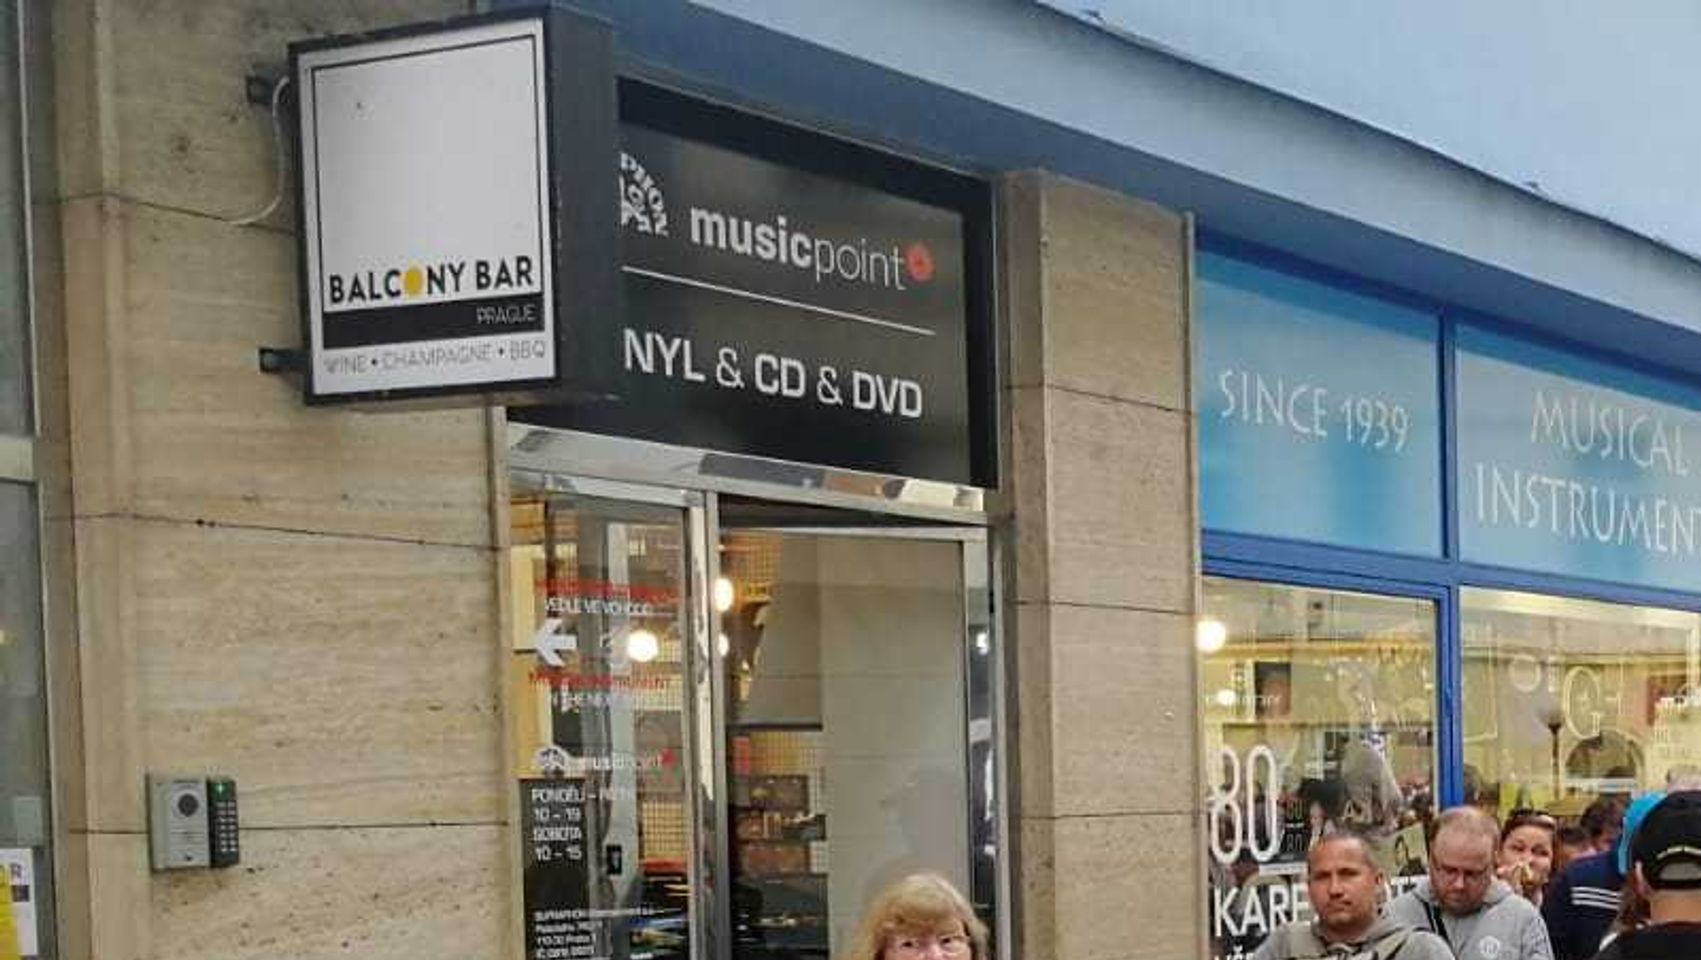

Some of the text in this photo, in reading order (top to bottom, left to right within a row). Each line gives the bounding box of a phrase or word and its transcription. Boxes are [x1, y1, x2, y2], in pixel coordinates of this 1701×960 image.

[329, 255, 533, 304] BALCONY BAR
[690, 206, 906, 290] musicpoint
[476, 303, 537, 325] PRAGUE
[381, 344, 493, 370] CHAMPAGNE
[510, 339, 546, 361] BBQ
[623, 328, 922, 418] NYL & CD & DVD
[1218, 368, 1410, 452] SINCE 1939
[1530, 390, 1693, 478] MUSICAL
[1214, 883, 1309, 937] KARE
